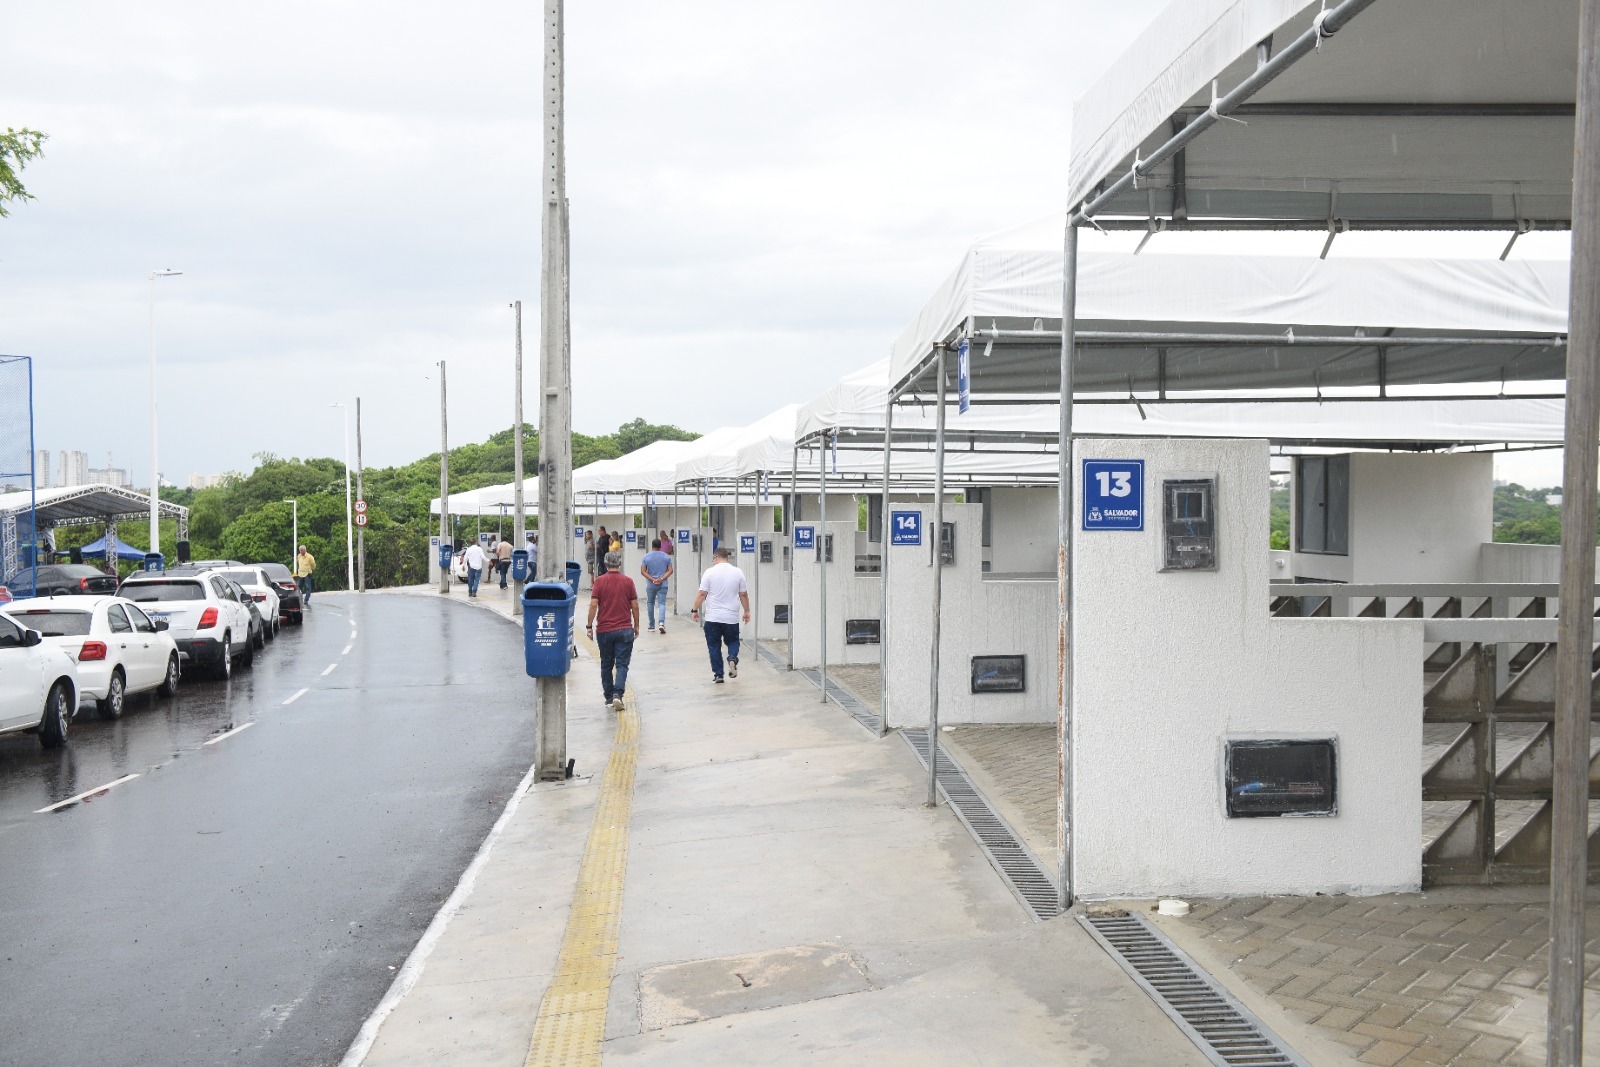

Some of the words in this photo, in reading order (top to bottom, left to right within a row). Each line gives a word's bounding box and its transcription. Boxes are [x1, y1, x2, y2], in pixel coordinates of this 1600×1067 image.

[1095, 471, 1132, 497] 13
[896, 516, 917, 530] 14
[798, 529, 811, 539] 15
